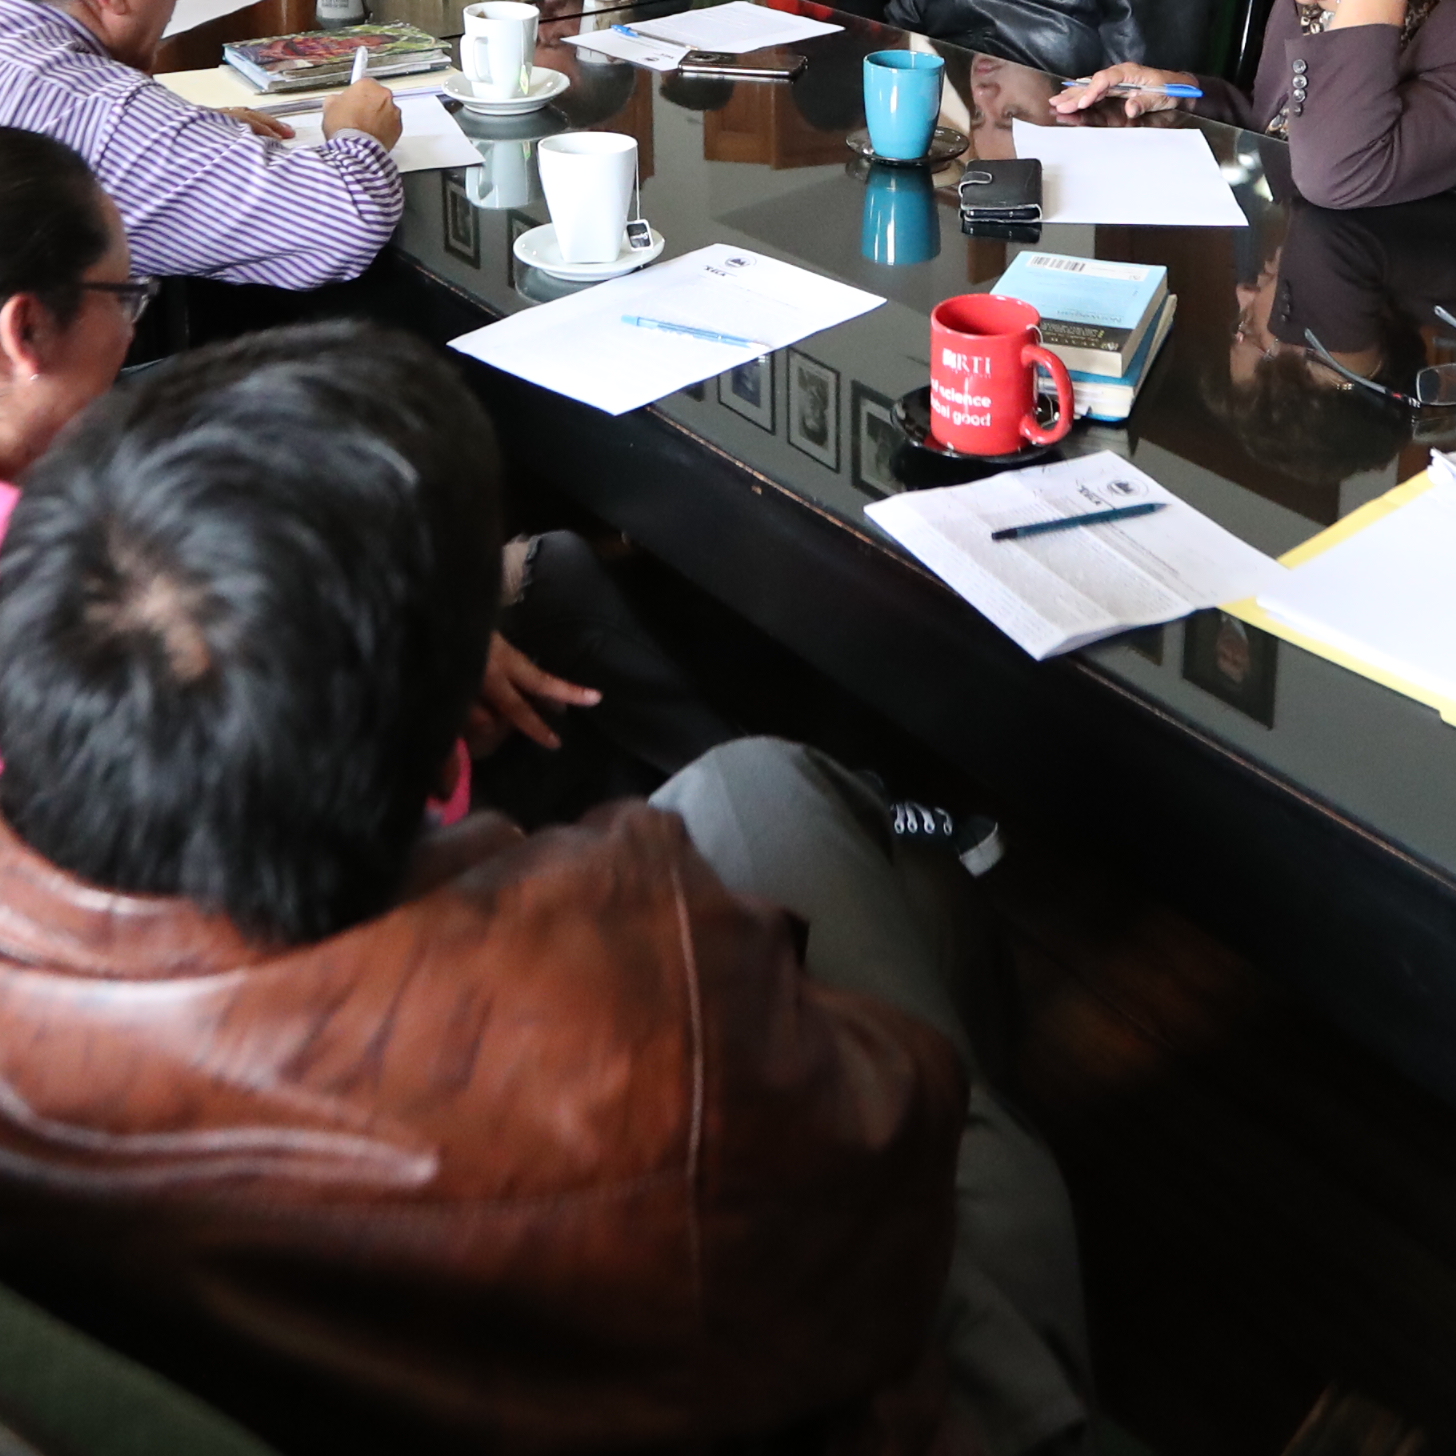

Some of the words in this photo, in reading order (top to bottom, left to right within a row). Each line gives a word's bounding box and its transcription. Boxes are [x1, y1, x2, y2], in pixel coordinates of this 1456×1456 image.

[956, 353, 992, 374] RTI
[939, 385, 992, 408] science
[952, 410, 992, 427] good
